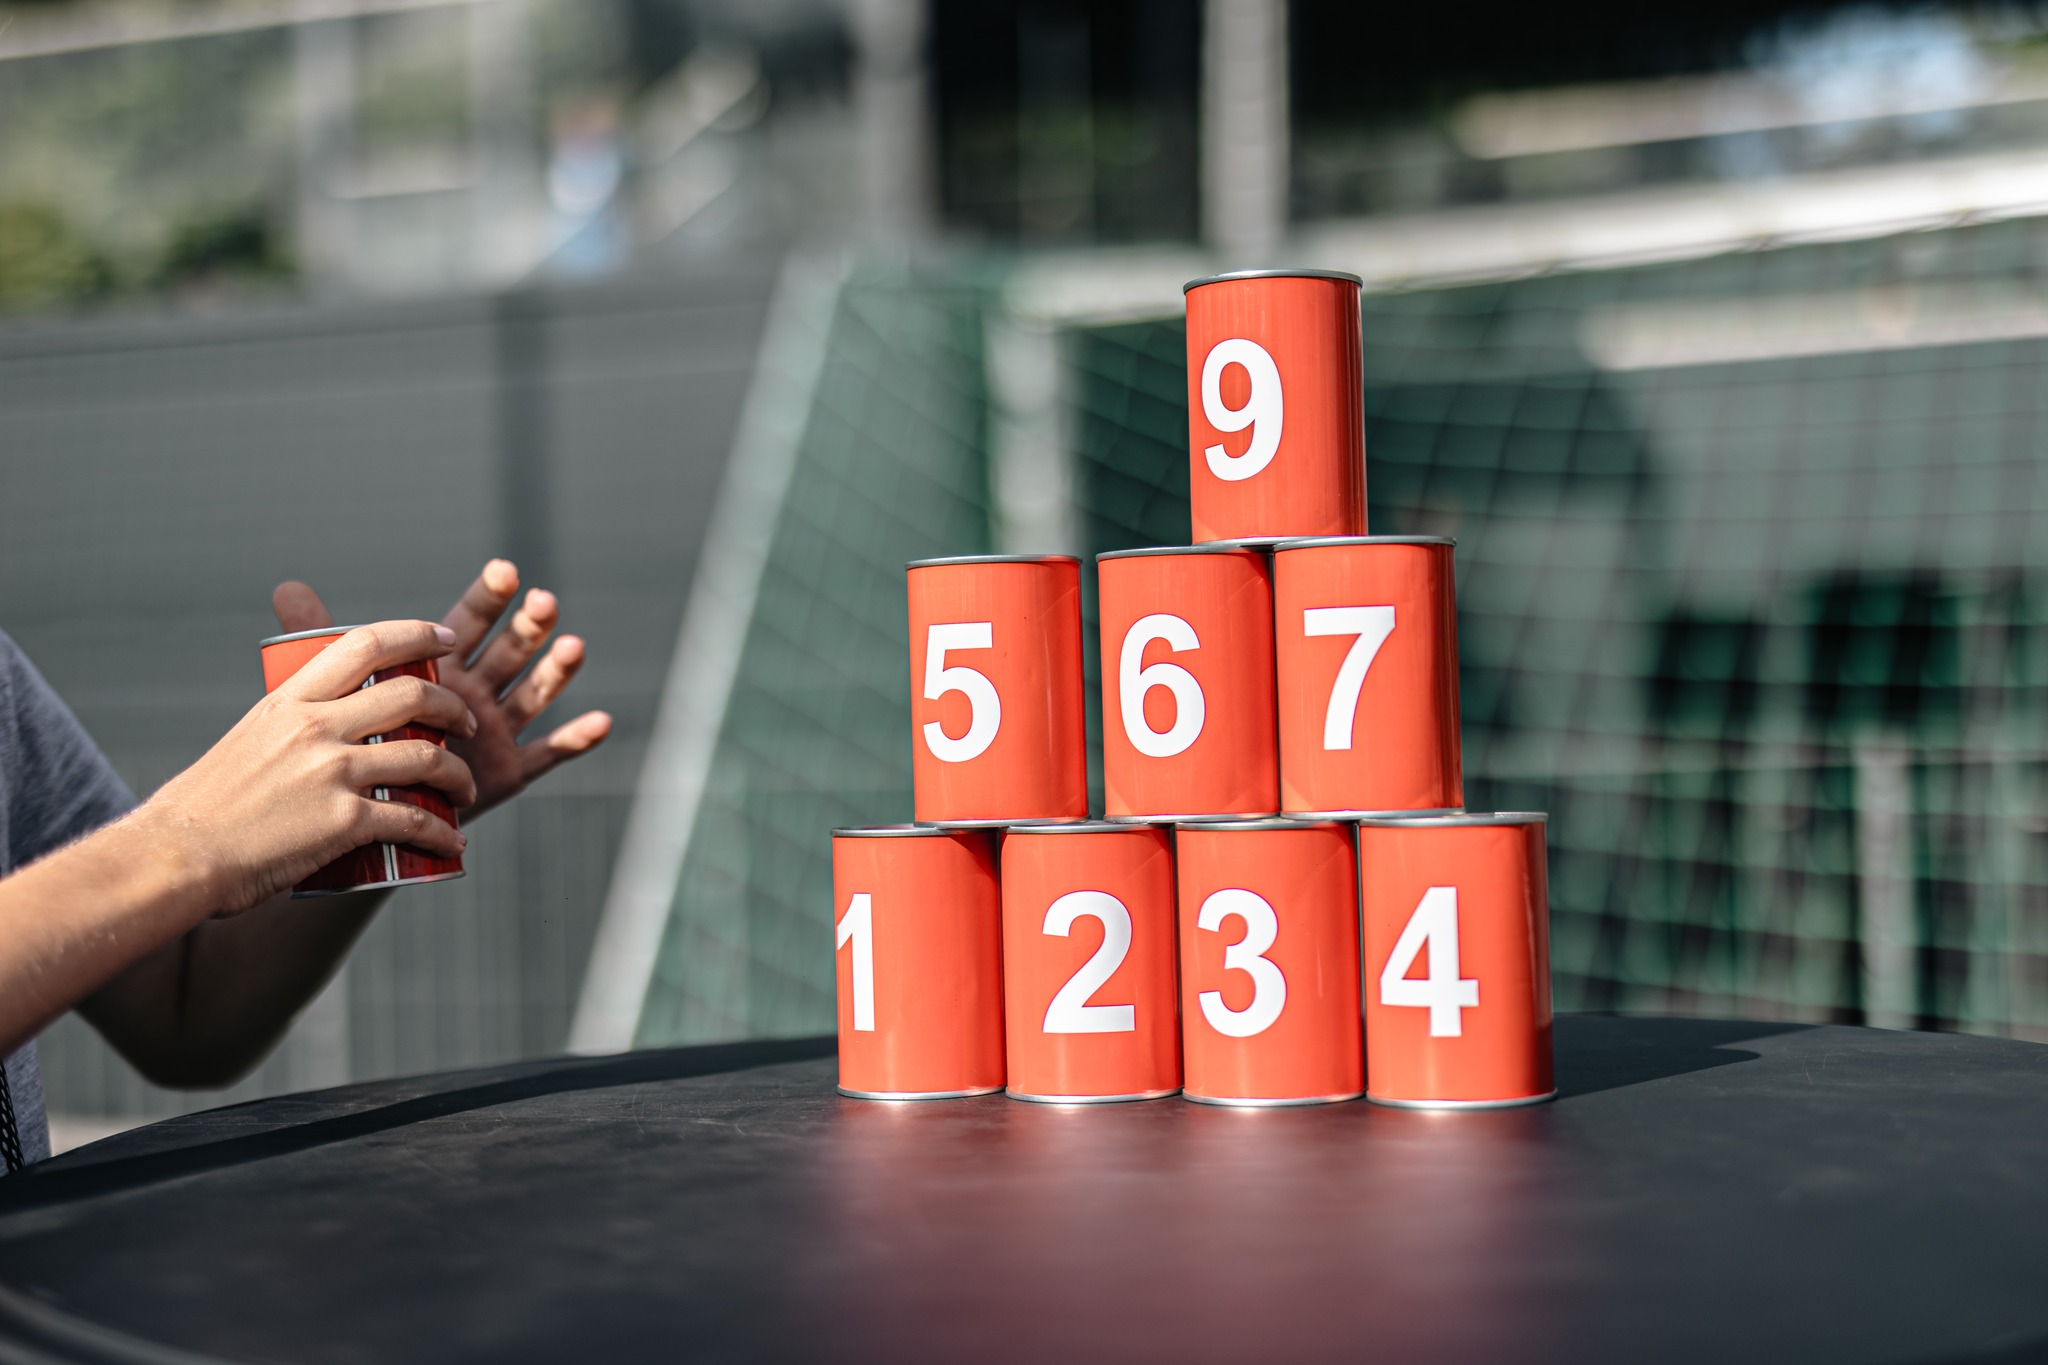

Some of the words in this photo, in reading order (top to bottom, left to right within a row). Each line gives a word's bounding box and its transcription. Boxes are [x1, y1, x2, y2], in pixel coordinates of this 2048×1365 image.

[1201, 338, 1284, 481] 9
[922, 621, 1001, 763] 5
[1119, 613, 1205, 758] 6
[1303, 605, 1395, 751] 7
[837, 893, 875, 1032] 1
[1042, 891, 1135, 1034] 2
[1197, 889, 1286, 1038] 3
[1380, 886, 1479, 1038] 4
